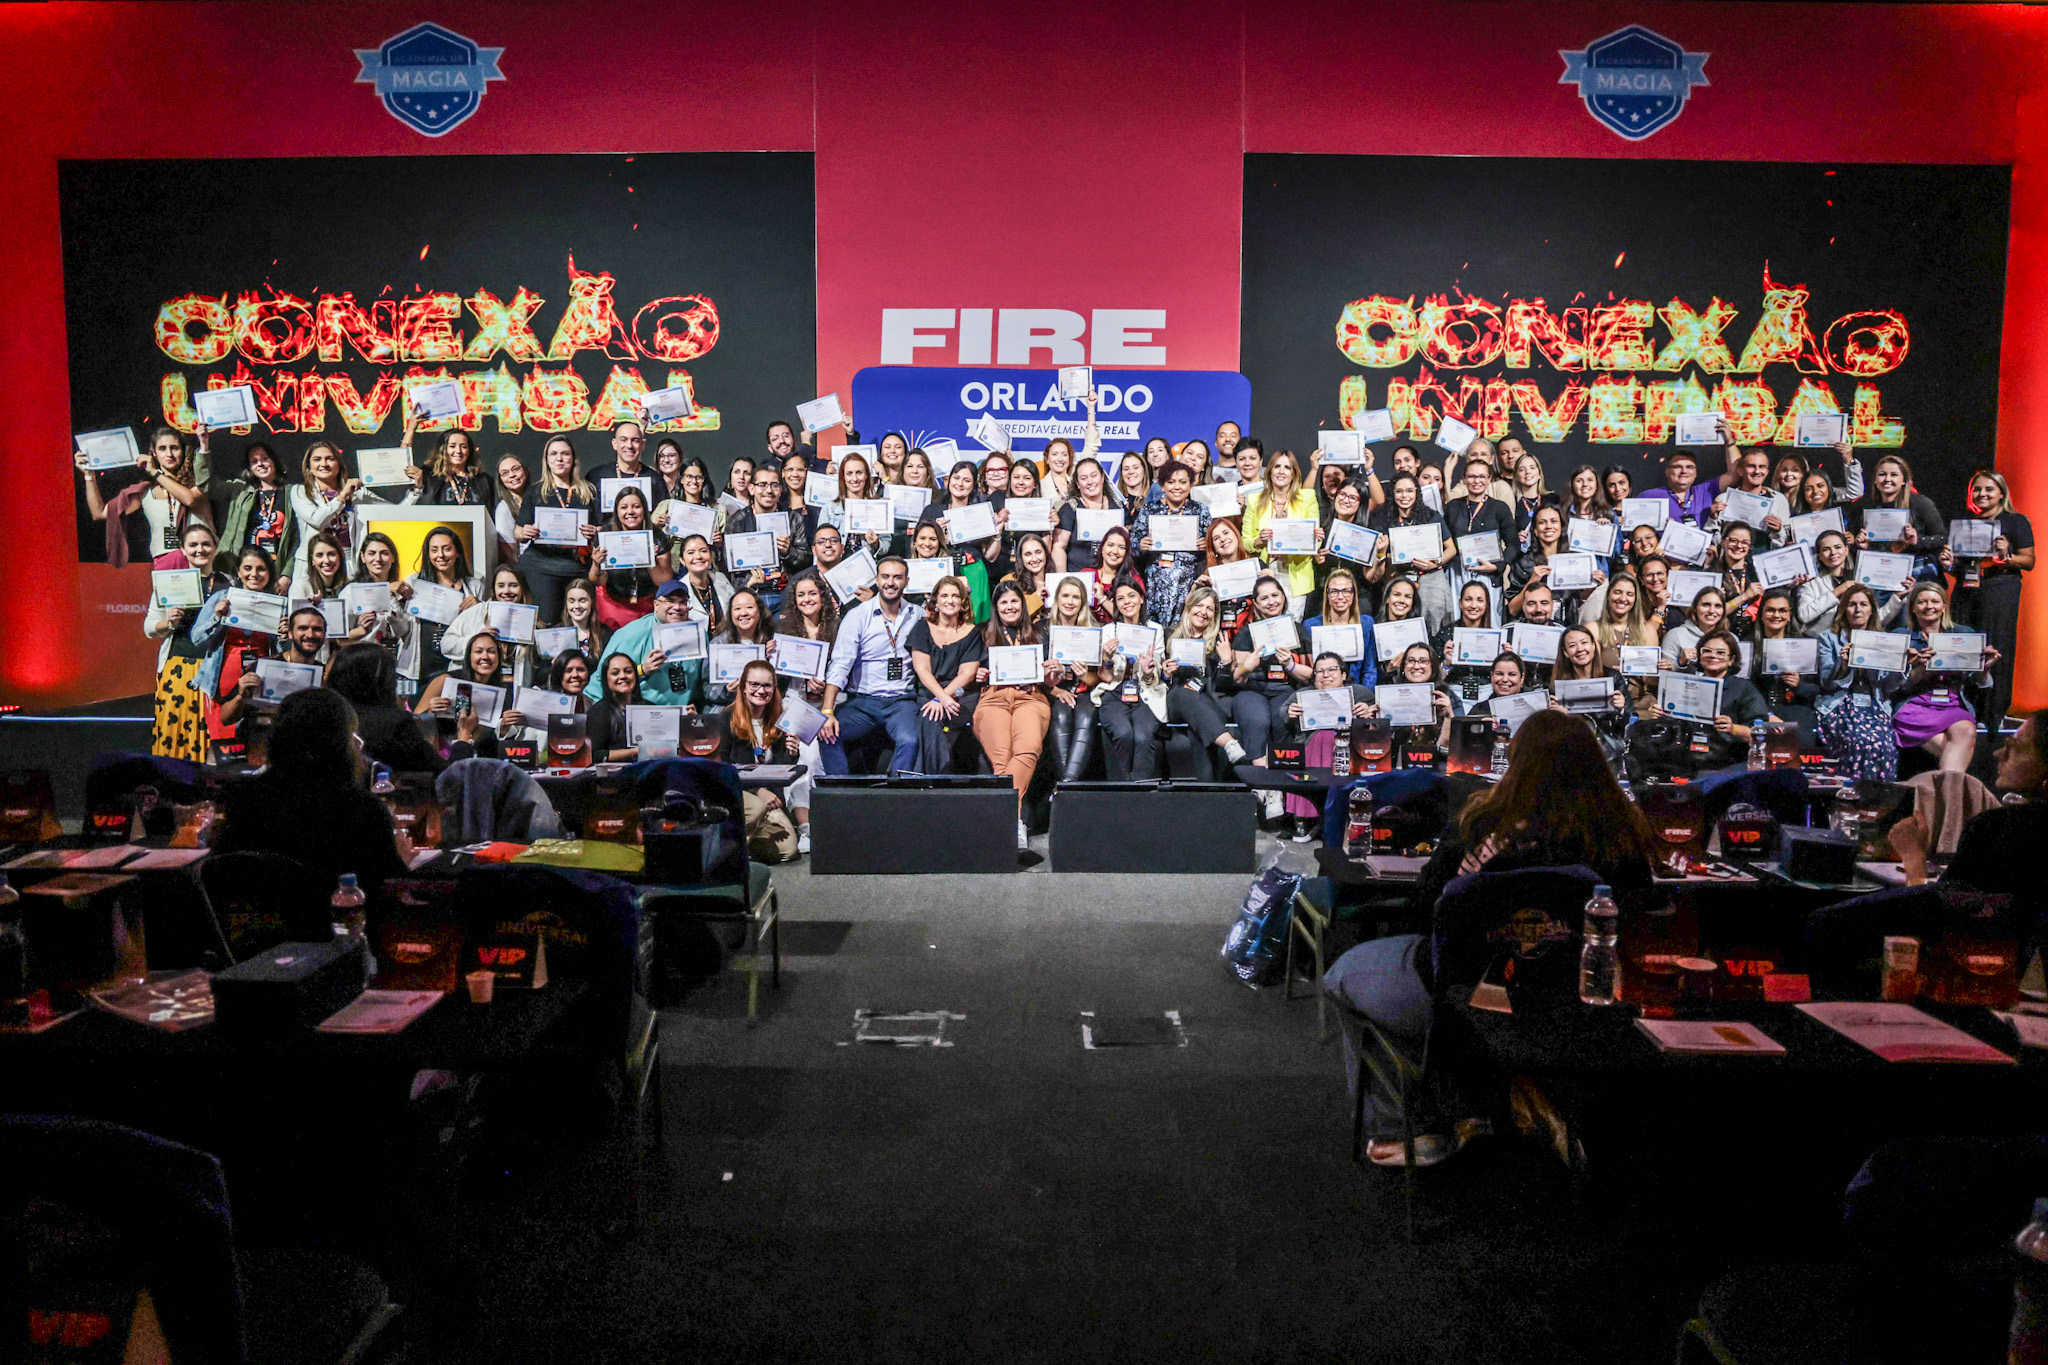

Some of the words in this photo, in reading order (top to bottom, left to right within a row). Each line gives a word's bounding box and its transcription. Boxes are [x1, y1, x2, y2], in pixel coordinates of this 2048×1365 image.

[393, 70, 469, 88] MAGIA
[1596, 73, 1672, 90] MAGIA
[880, 308, 1166, 366] FIRE
[1104, 425, 1131, 435] REAL
[106, 604, 148, 613] FLORIDA
[219, 744, 245, 754] VIP
[505, 747, 531, 756] VIP
[1274, 749, 1300, 759] VIP
[1408, 752, 1434, 761] VIP
[1800, 755, 1826, 764] VIP
[93, 815, 126, 827] VIP
[1728, 831, 1761, 842] VIP
[478, 948, 526, 964] VIP
[1725, 959, 1775, 976] VIP
[26, 1306, 112, 1349] VIP
